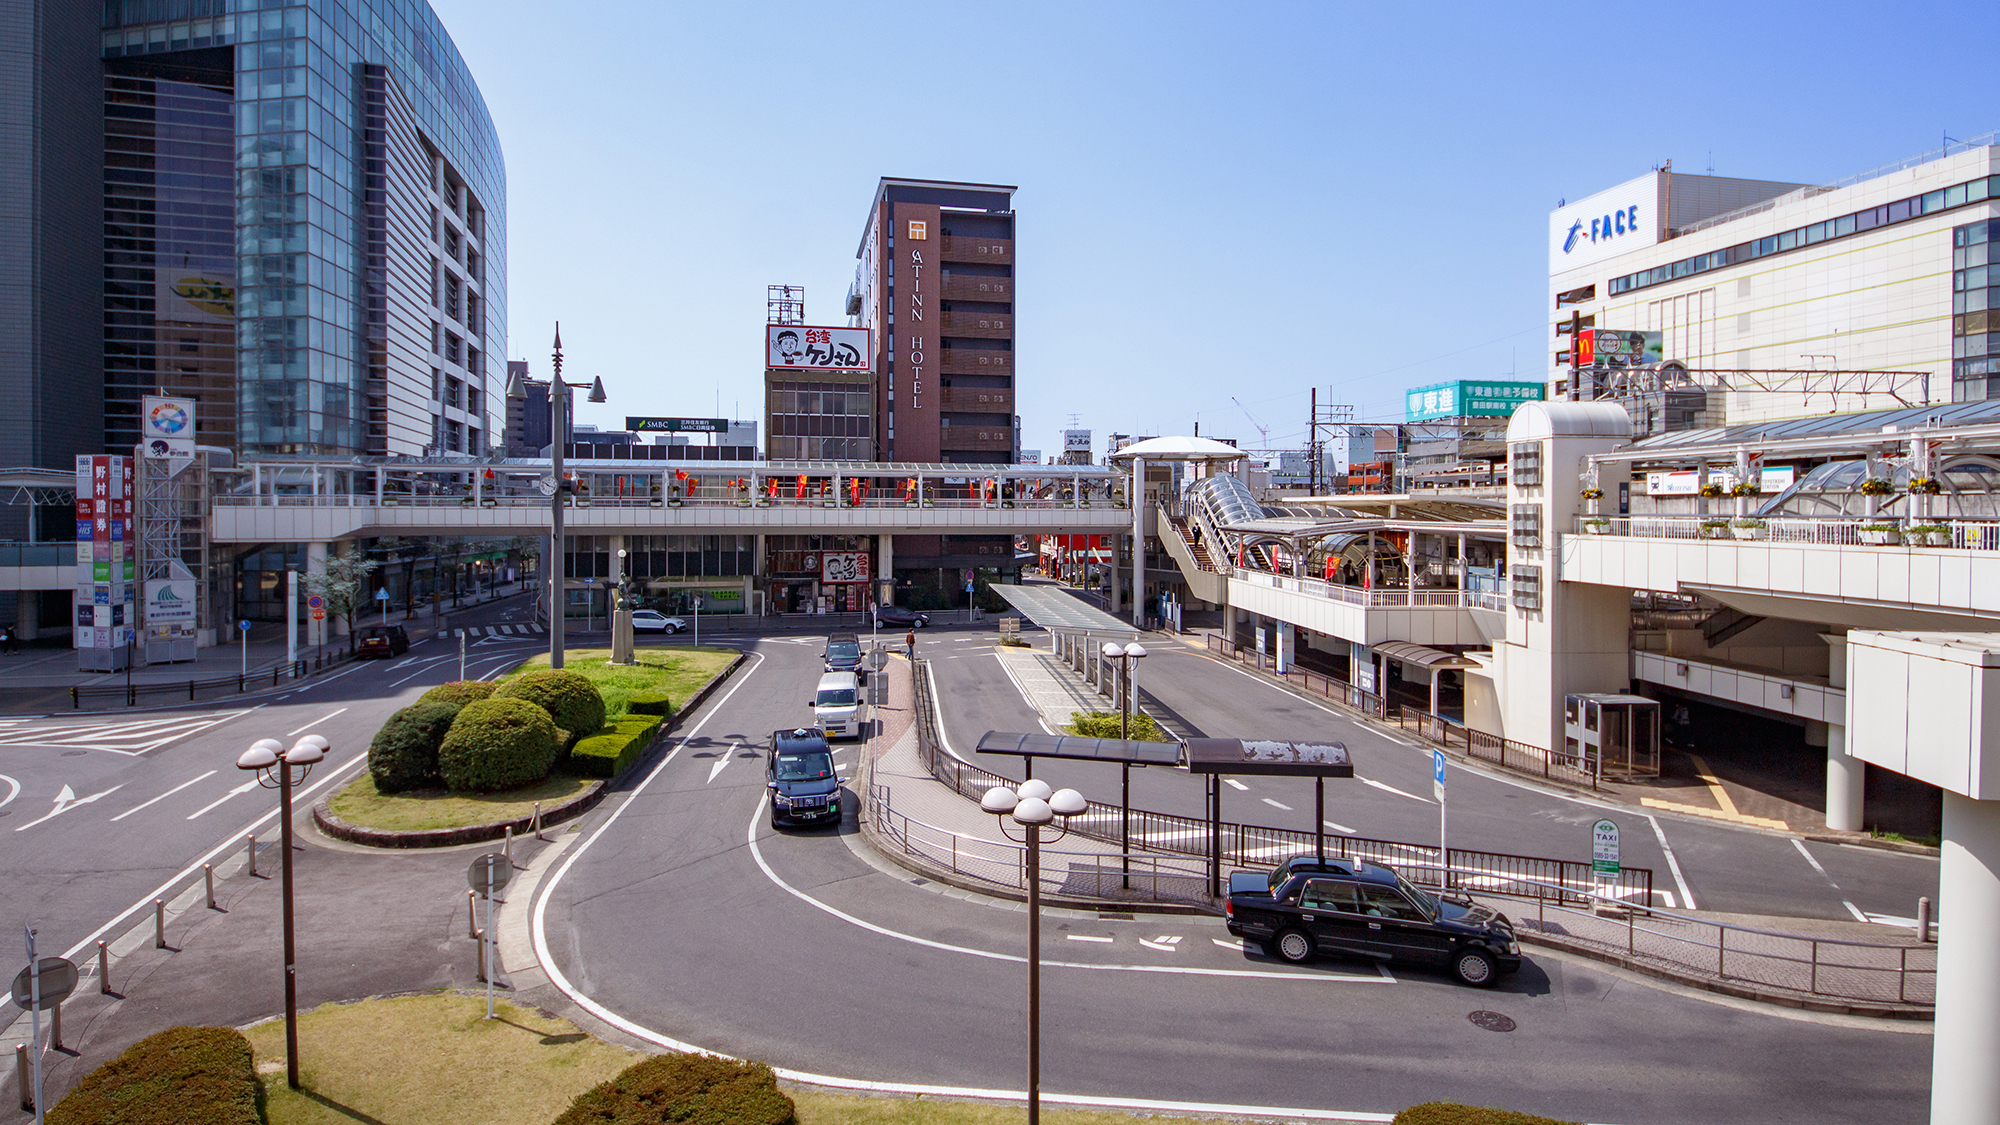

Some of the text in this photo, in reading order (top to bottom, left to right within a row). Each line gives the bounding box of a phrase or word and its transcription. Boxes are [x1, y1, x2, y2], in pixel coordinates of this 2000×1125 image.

[805, 329, 832, 344] 台湾
[805, 343, 861, 367] ケンさん
[911, 337, 924, 409] HOTEL
[1423, 388, 1454, 415] 東進
[1435, 753, 1443, 778] P
[1596, 833, 1617, 842] TAXI
